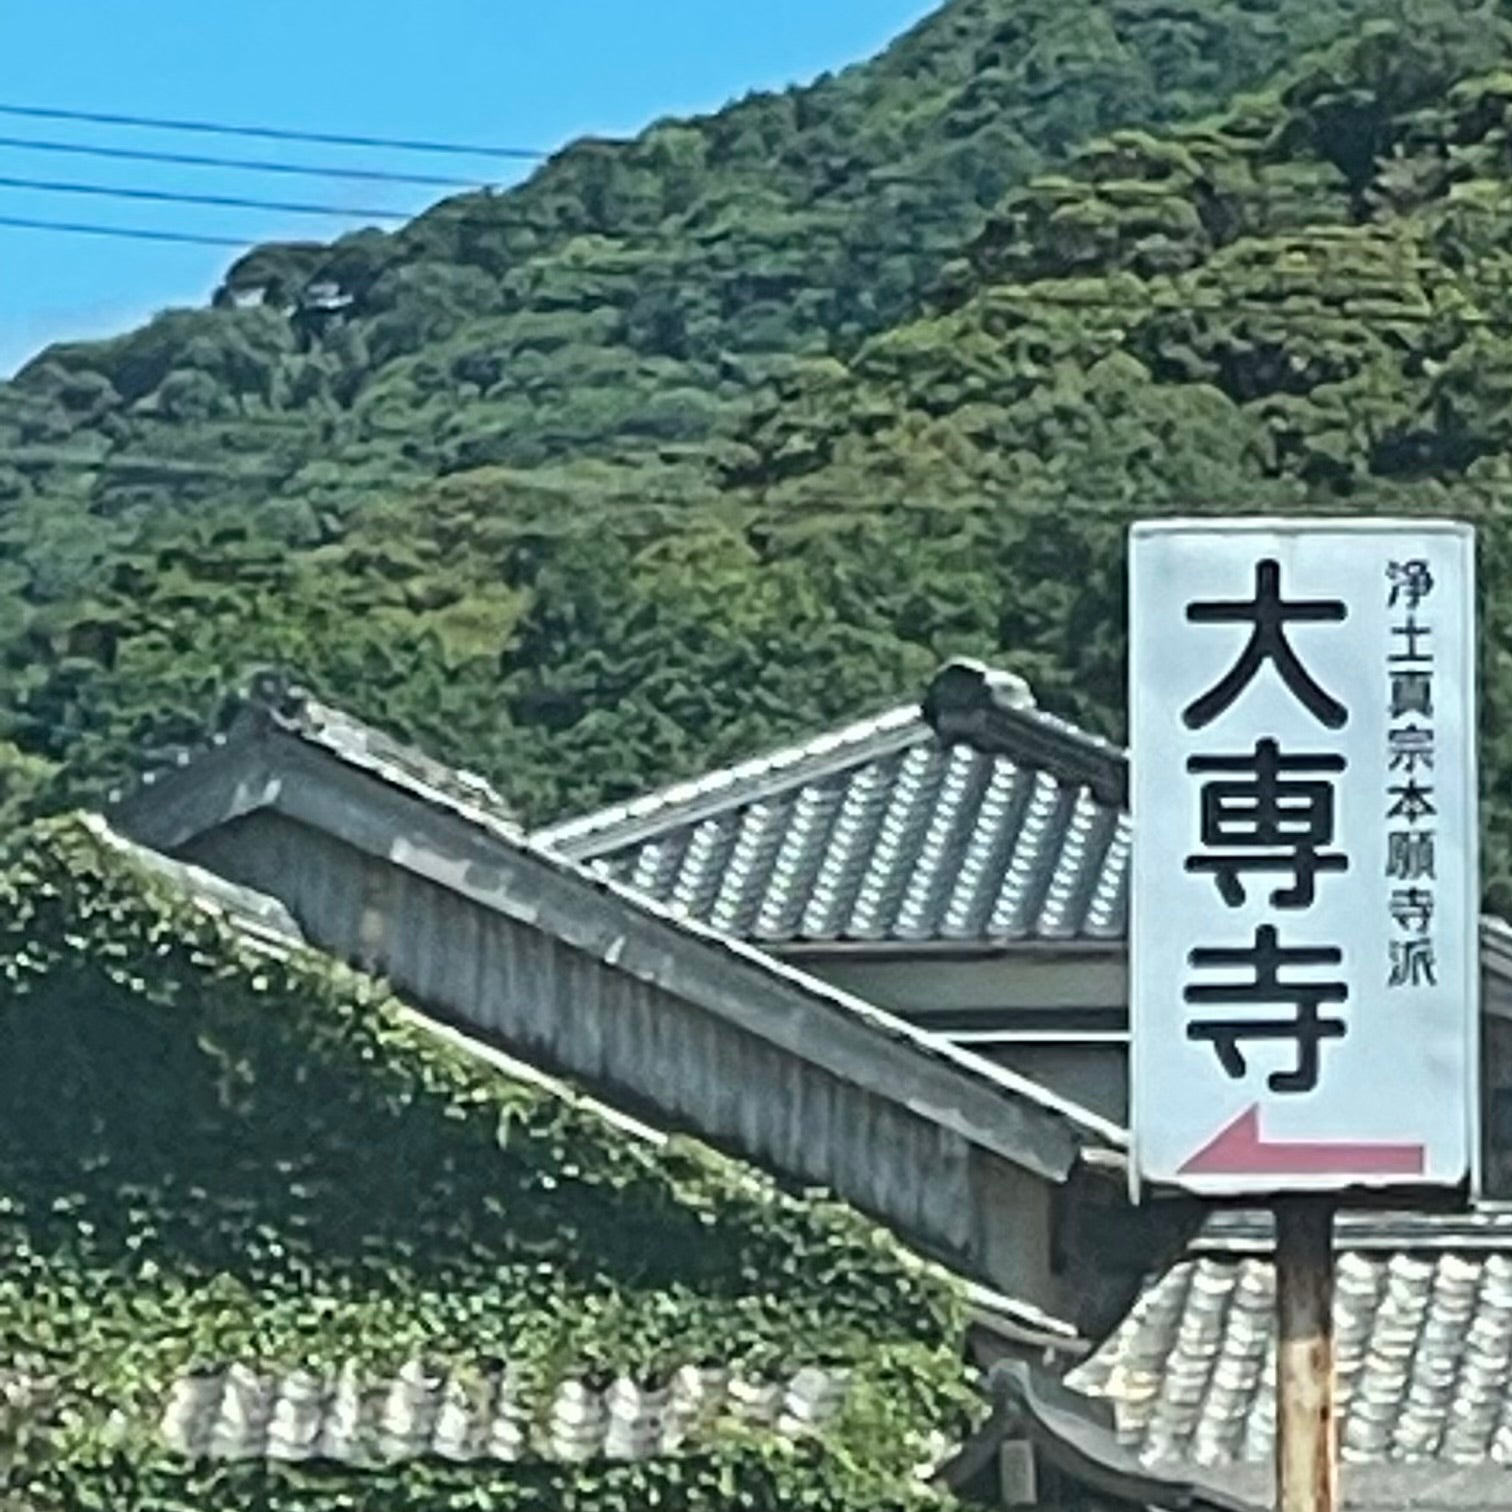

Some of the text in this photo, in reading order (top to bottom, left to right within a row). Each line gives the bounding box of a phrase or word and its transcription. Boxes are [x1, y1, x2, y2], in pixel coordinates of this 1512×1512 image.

[1182, 558, 1348, 1092] 大専寺
[1385, 558, 1437, 987] 浄土真宗本願寺派
